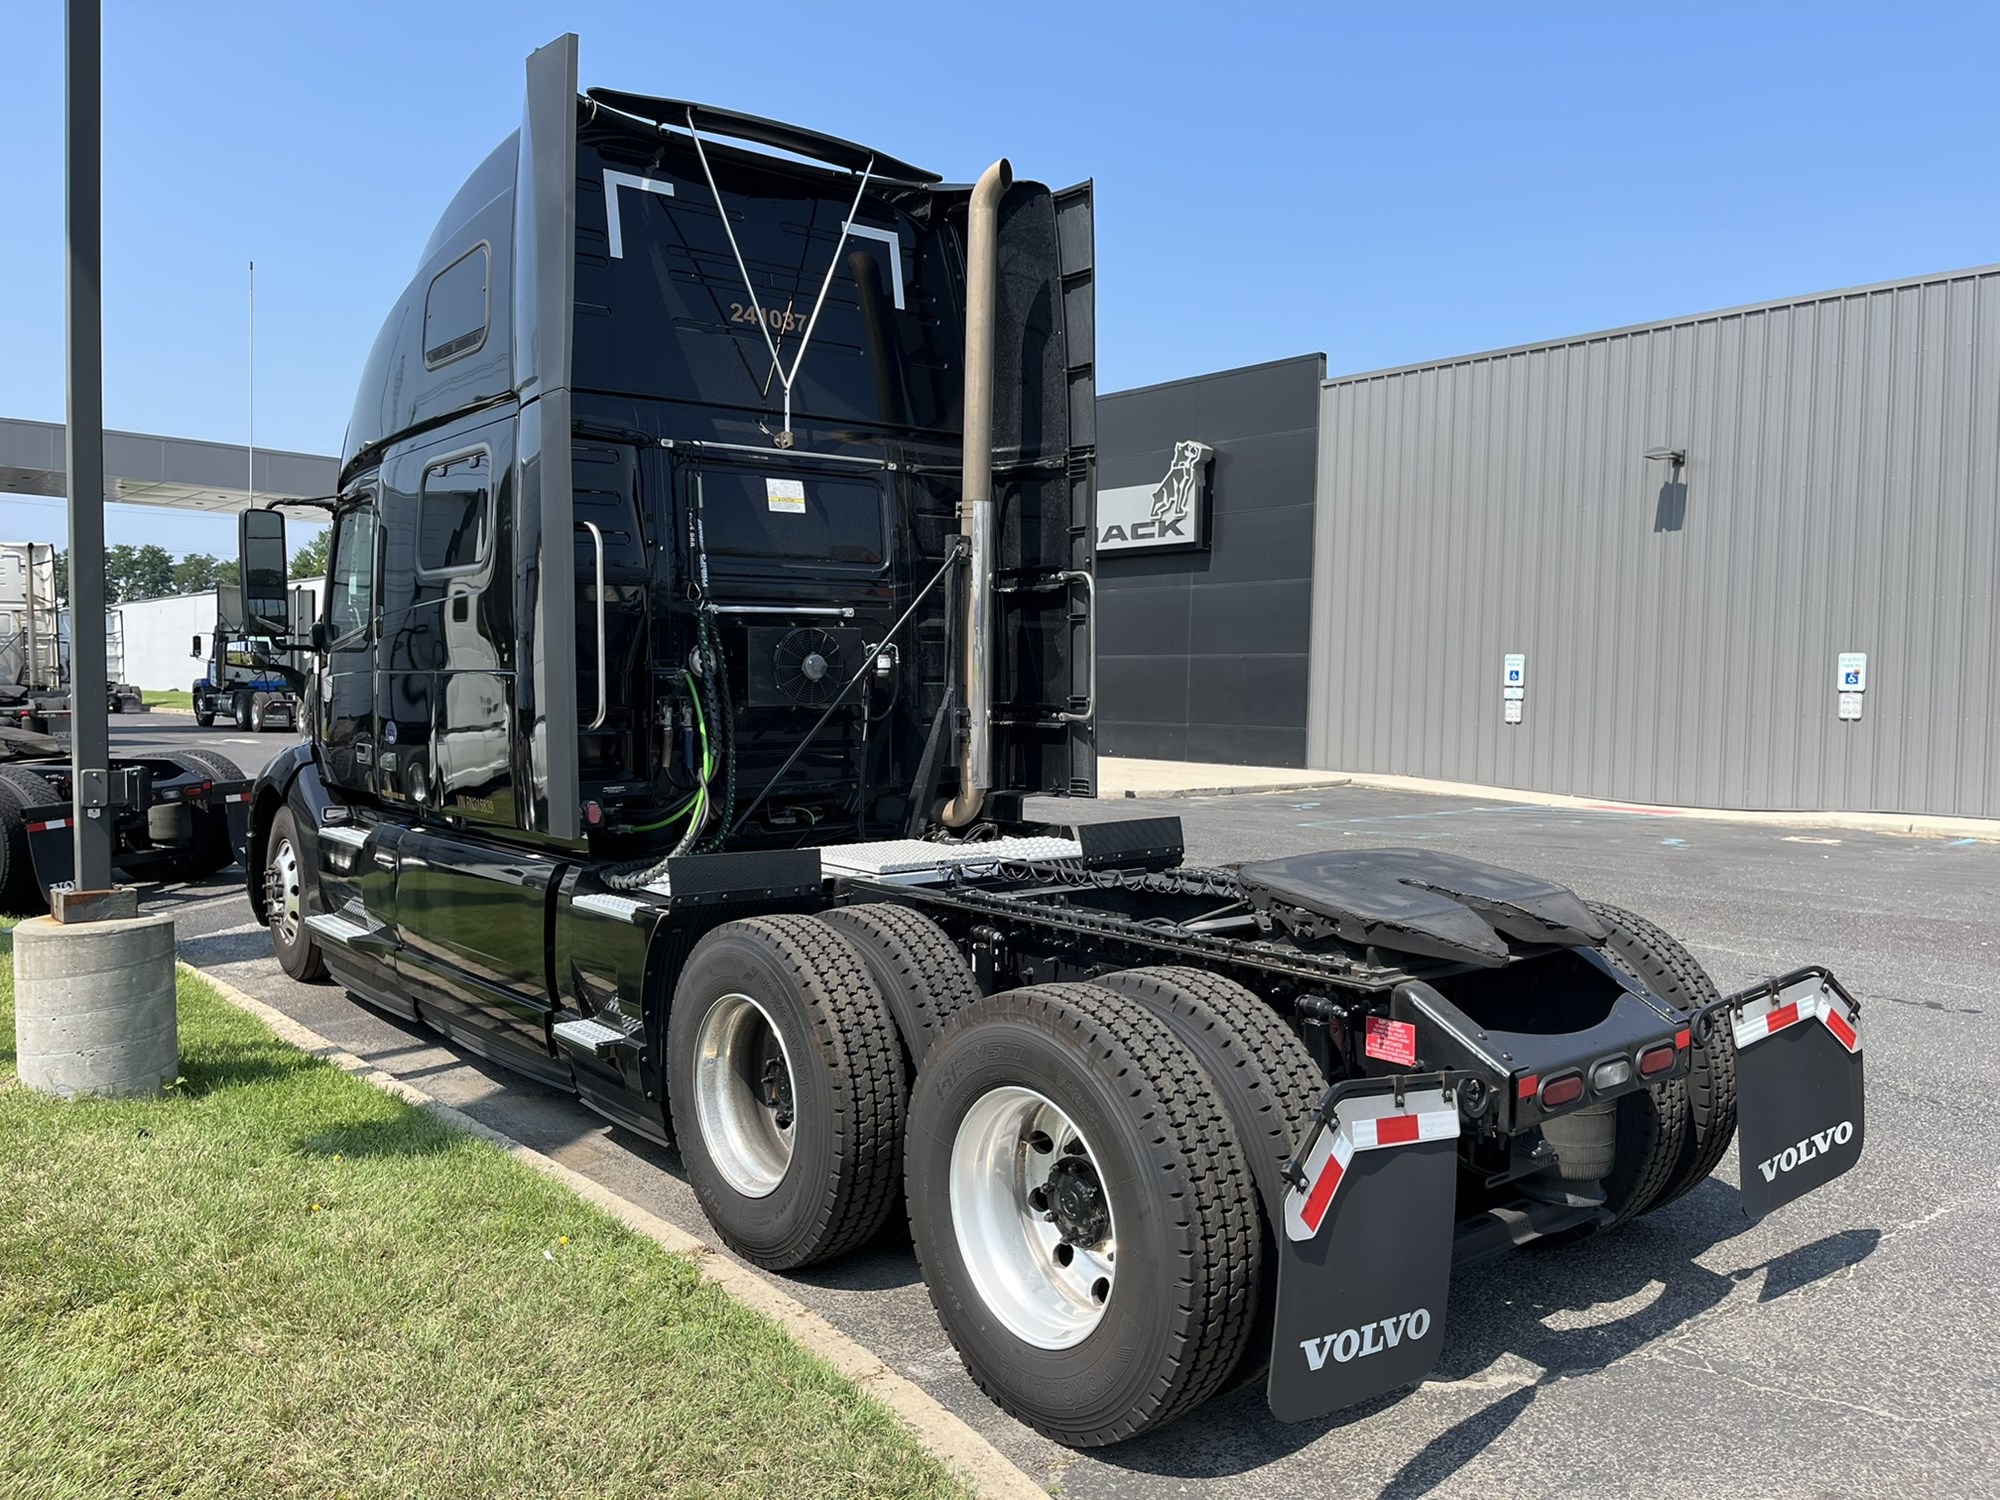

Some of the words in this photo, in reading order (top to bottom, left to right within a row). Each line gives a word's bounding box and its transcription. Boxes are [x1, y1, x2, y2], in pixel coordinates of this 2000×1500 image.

[729, 302, 807, 332] 241037
[1097, 518, 1185, 543] ACK
[1758, 1121, 1853, 1182] VOLVO
[1300, 1308, 1430, 1371] VOLVO
